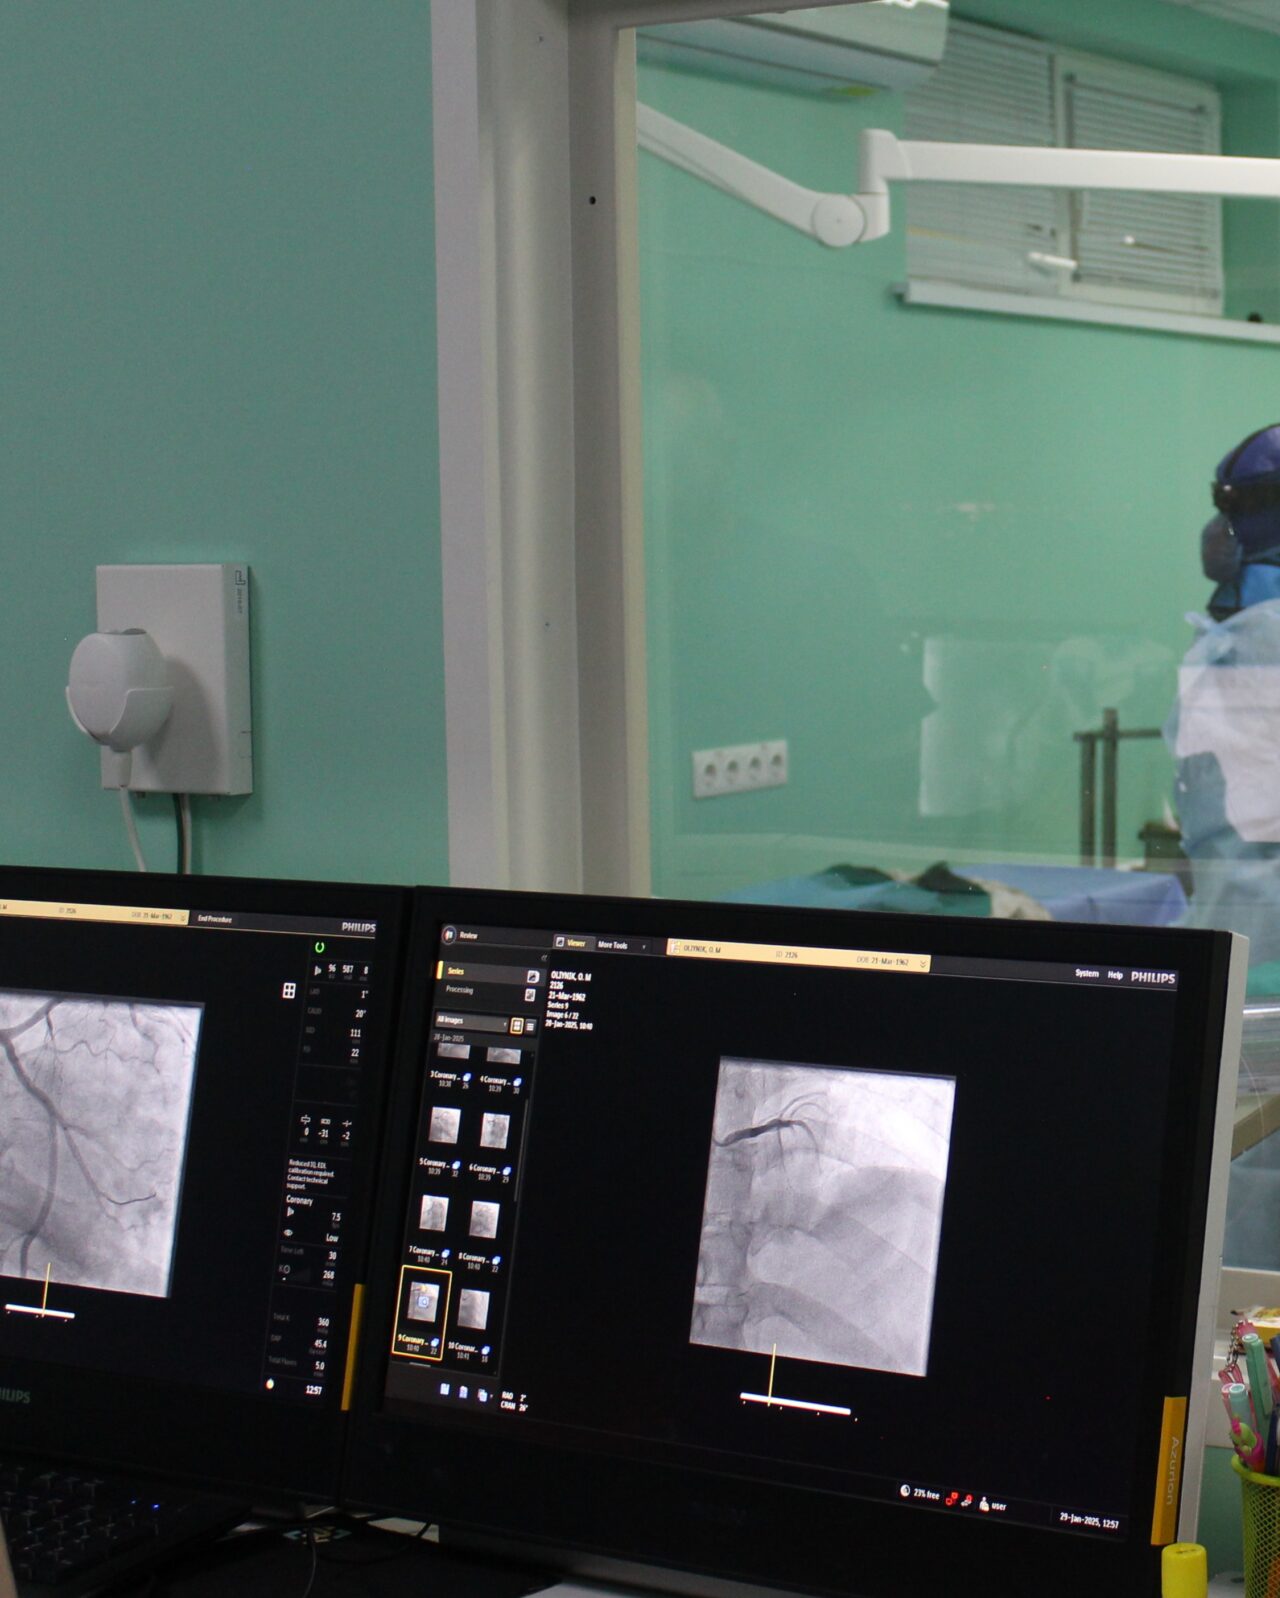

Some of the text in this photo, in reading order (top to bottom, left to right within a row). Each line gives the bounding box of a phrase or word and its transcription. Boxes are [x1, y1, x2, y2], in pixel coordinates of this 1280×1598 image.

[341, 921, 377, 933] PHILIPS
[459, 931, 478, 940] Review
[567, 938, 628, 950] Viewer More Tools
[447, 967, 465, 976] Series
[1075, 968, 1176, 984] System Help PHILIPS
[446, 984, 474, 995] Processing
[547, 1001, 569, 1010] Series 9
[546, 1010, 564, 1020] Image
[350, 1048, 360, 1057] 22
[288, 1167, 313, 1175] calibration
[306, 1176, 329, 1184] technical
[286, 1194, 314, 1207] Coronary
[326, 1233, 339, 1242] Low
[305, 1384, 323, 1395] 12:57
[0, 1386, 31, 1404] ILIPS
[500, 1401, 516, 1410] CRAN
[1165, 1435, 1180, 1506] Azurion
[926, 1490, 940, 1500] free
[991, 1501, 1007, 1512] user
[1102, 1518, 1119, 1530] 12:57
